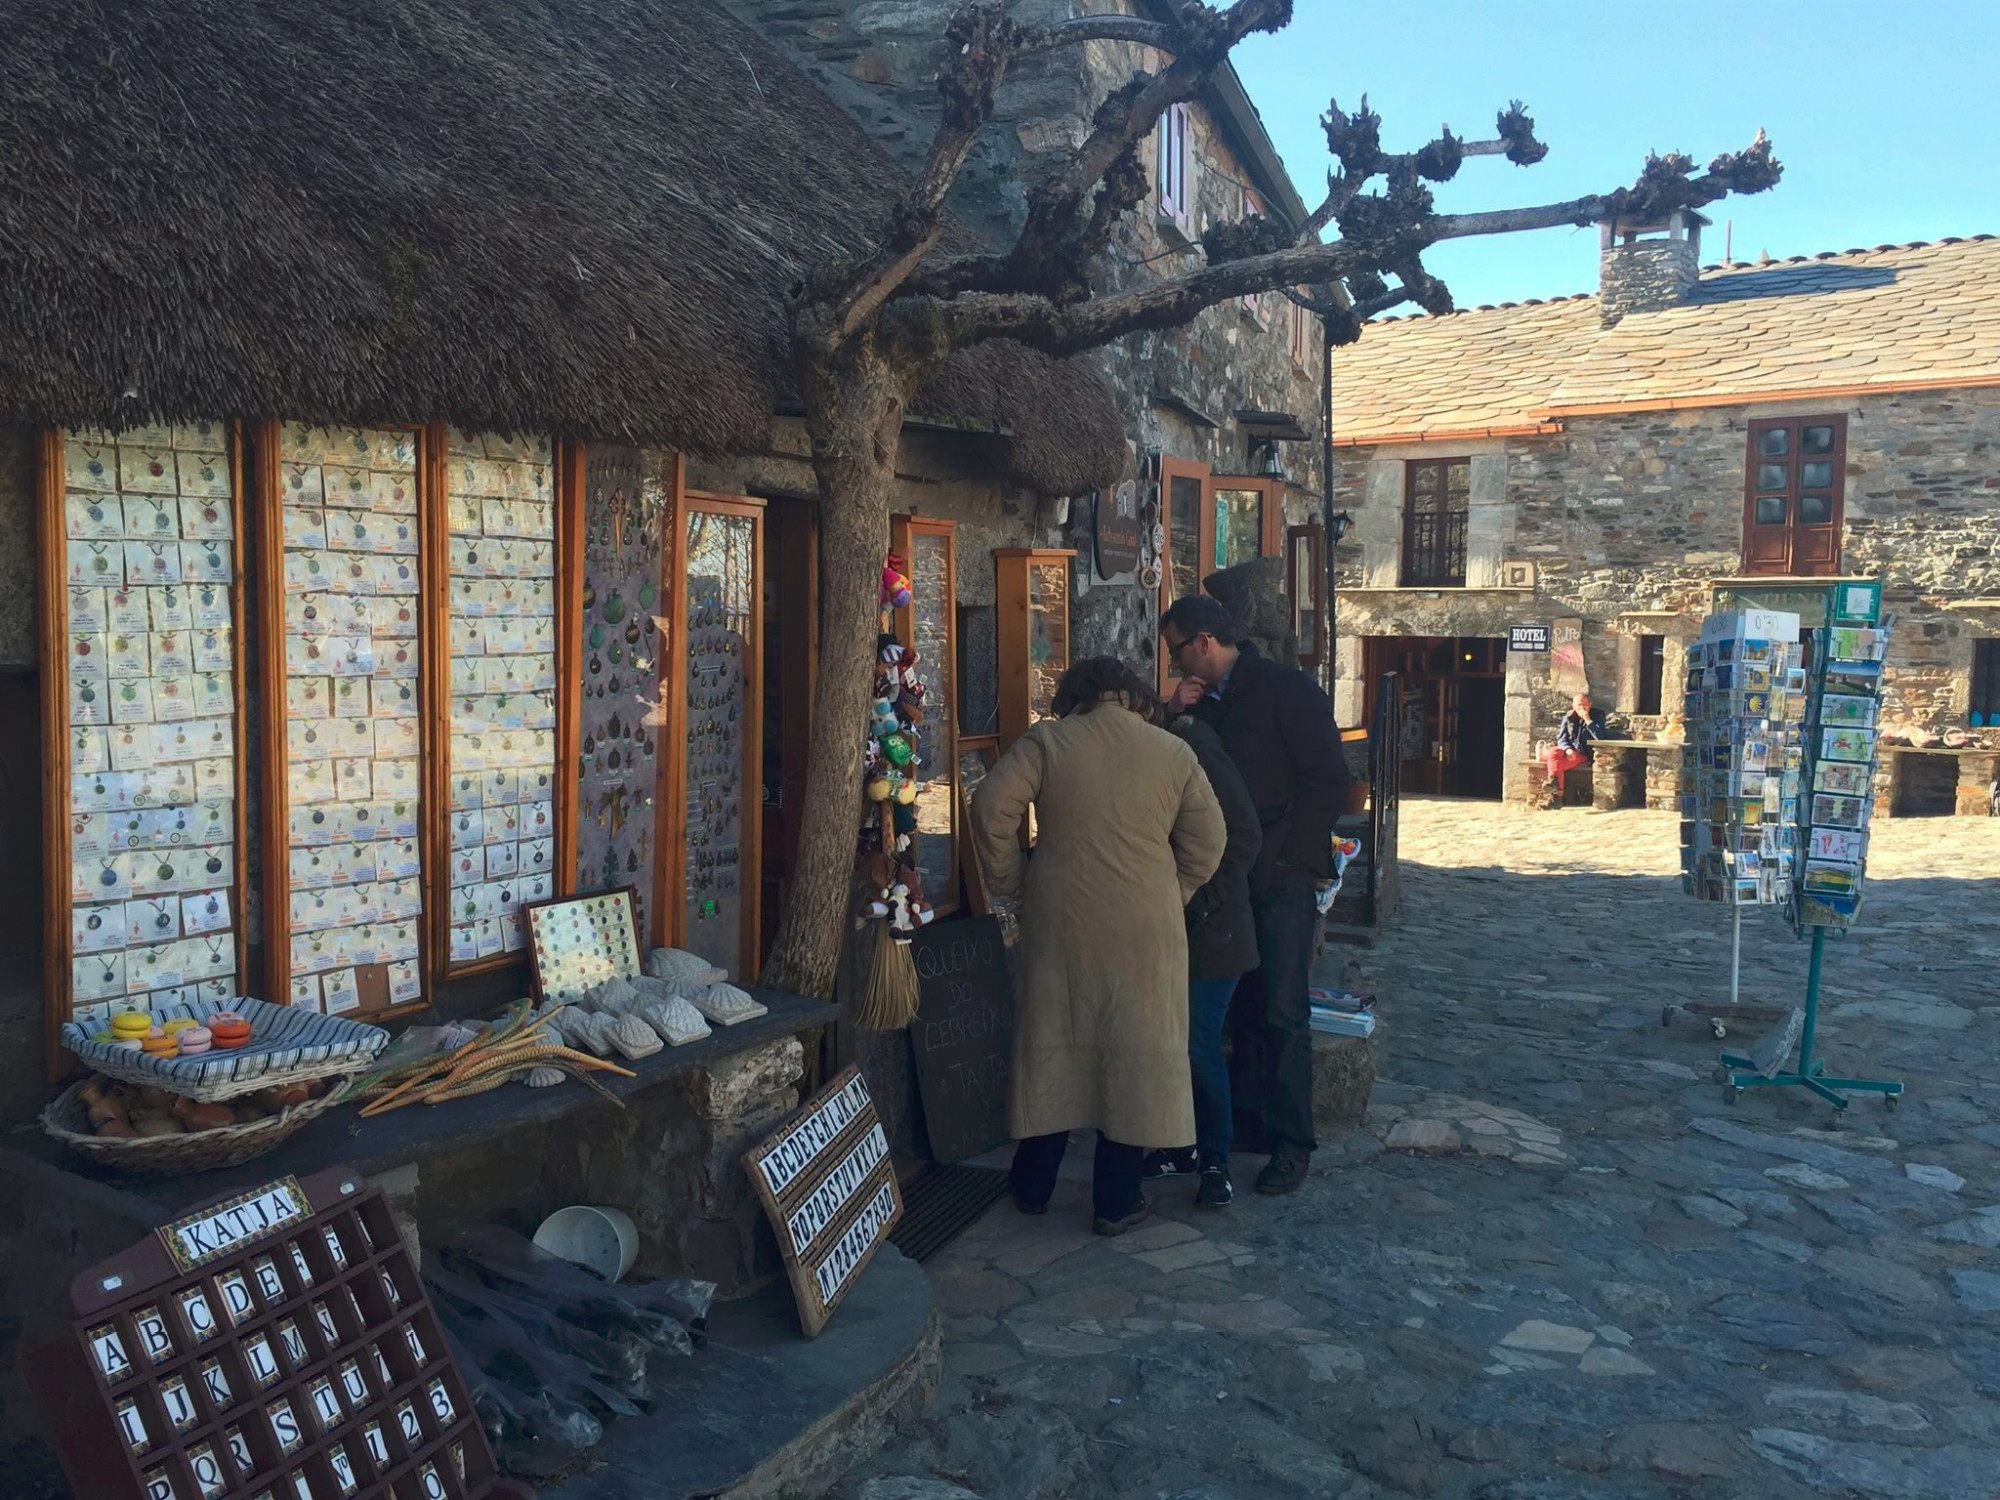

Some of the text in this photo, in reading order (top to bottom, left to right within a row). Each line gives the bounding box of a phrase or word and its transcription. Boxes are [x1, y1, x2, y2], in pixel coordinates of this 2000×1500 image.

[1512, 628, 1546, 642] HOTEL
[916, 935, 992, 979] QUEIXO
[946, 983, 973, 1009] DO
[185, 1191, 293, 1256] KATJA
[105, 1337, 127, 1371] A
[141, 1319, 169, 1353] B
[189, 1300, 211, 1331] C
[226, 1283, 249, 1315] D
[256, 1266, 282, 1298] E
[119, 1412, 141, 1446] I
[169, 1386, 189, 1423] J
[203, 1368, 231, 1403] K
[249, 1347, 276, 1380] L
[284, 1328, 307, 1361] M
[195, 1456, 222, 1485] Q
[275, 1410, 300, 1445] S
[314, 1385, 337, 1418] T
[344, 1369, 365, 1399] U
[366, 1433, 385, 1462] 1
[400, 1411, 419, 1441] 2
[430, 1390, 450, 1420] 3
